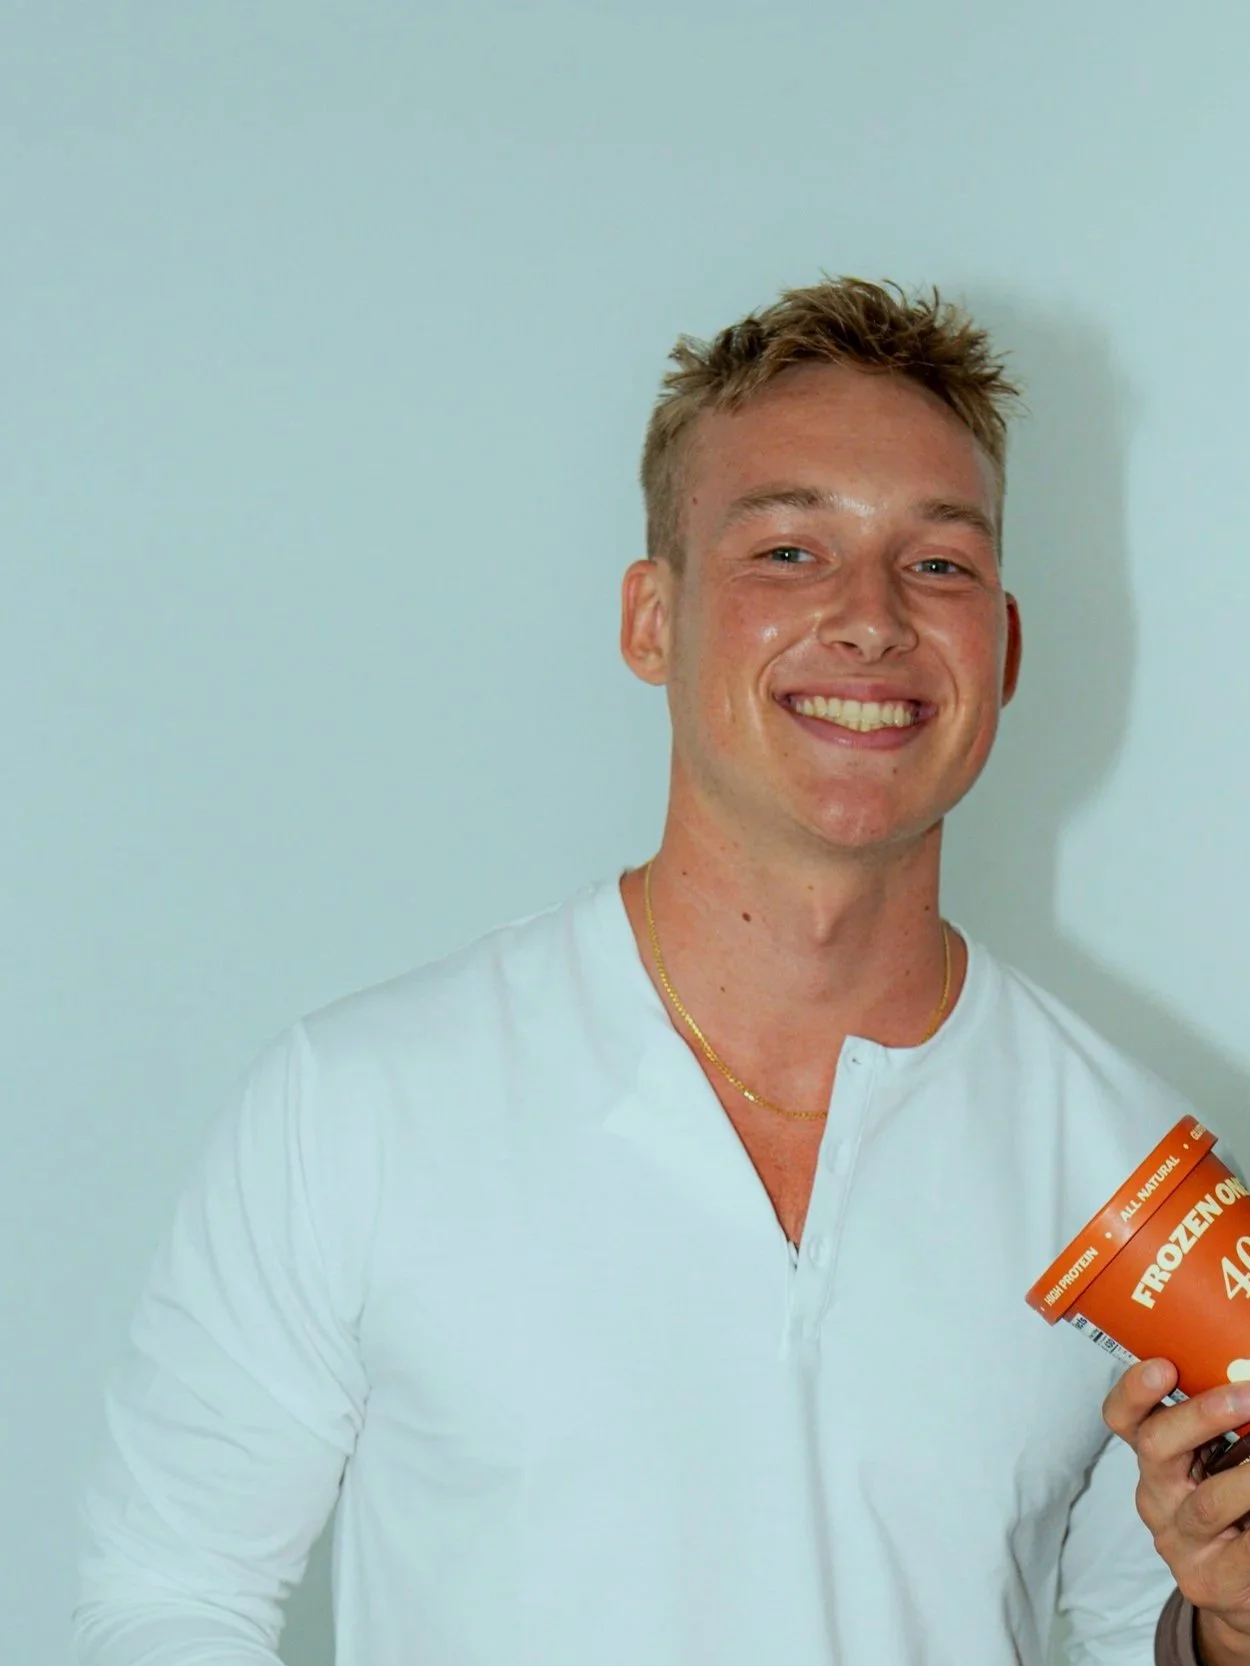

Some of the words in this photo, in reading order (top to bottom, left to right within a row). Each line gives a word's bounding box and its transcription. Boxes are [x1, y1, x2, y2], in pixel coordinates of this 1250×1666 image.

[1044, 1286, 1063, 1306] HIGH
[1058, 1246, 1099, 1290] PROTEIN
[1119, 1200, 1141, 1223] ALL
[1137, 1155, 1181, 1202] NATURAL
[1131, 1193, 1224, 1310] FROZEN
[1215, 1177, 1250, 1205] ON
